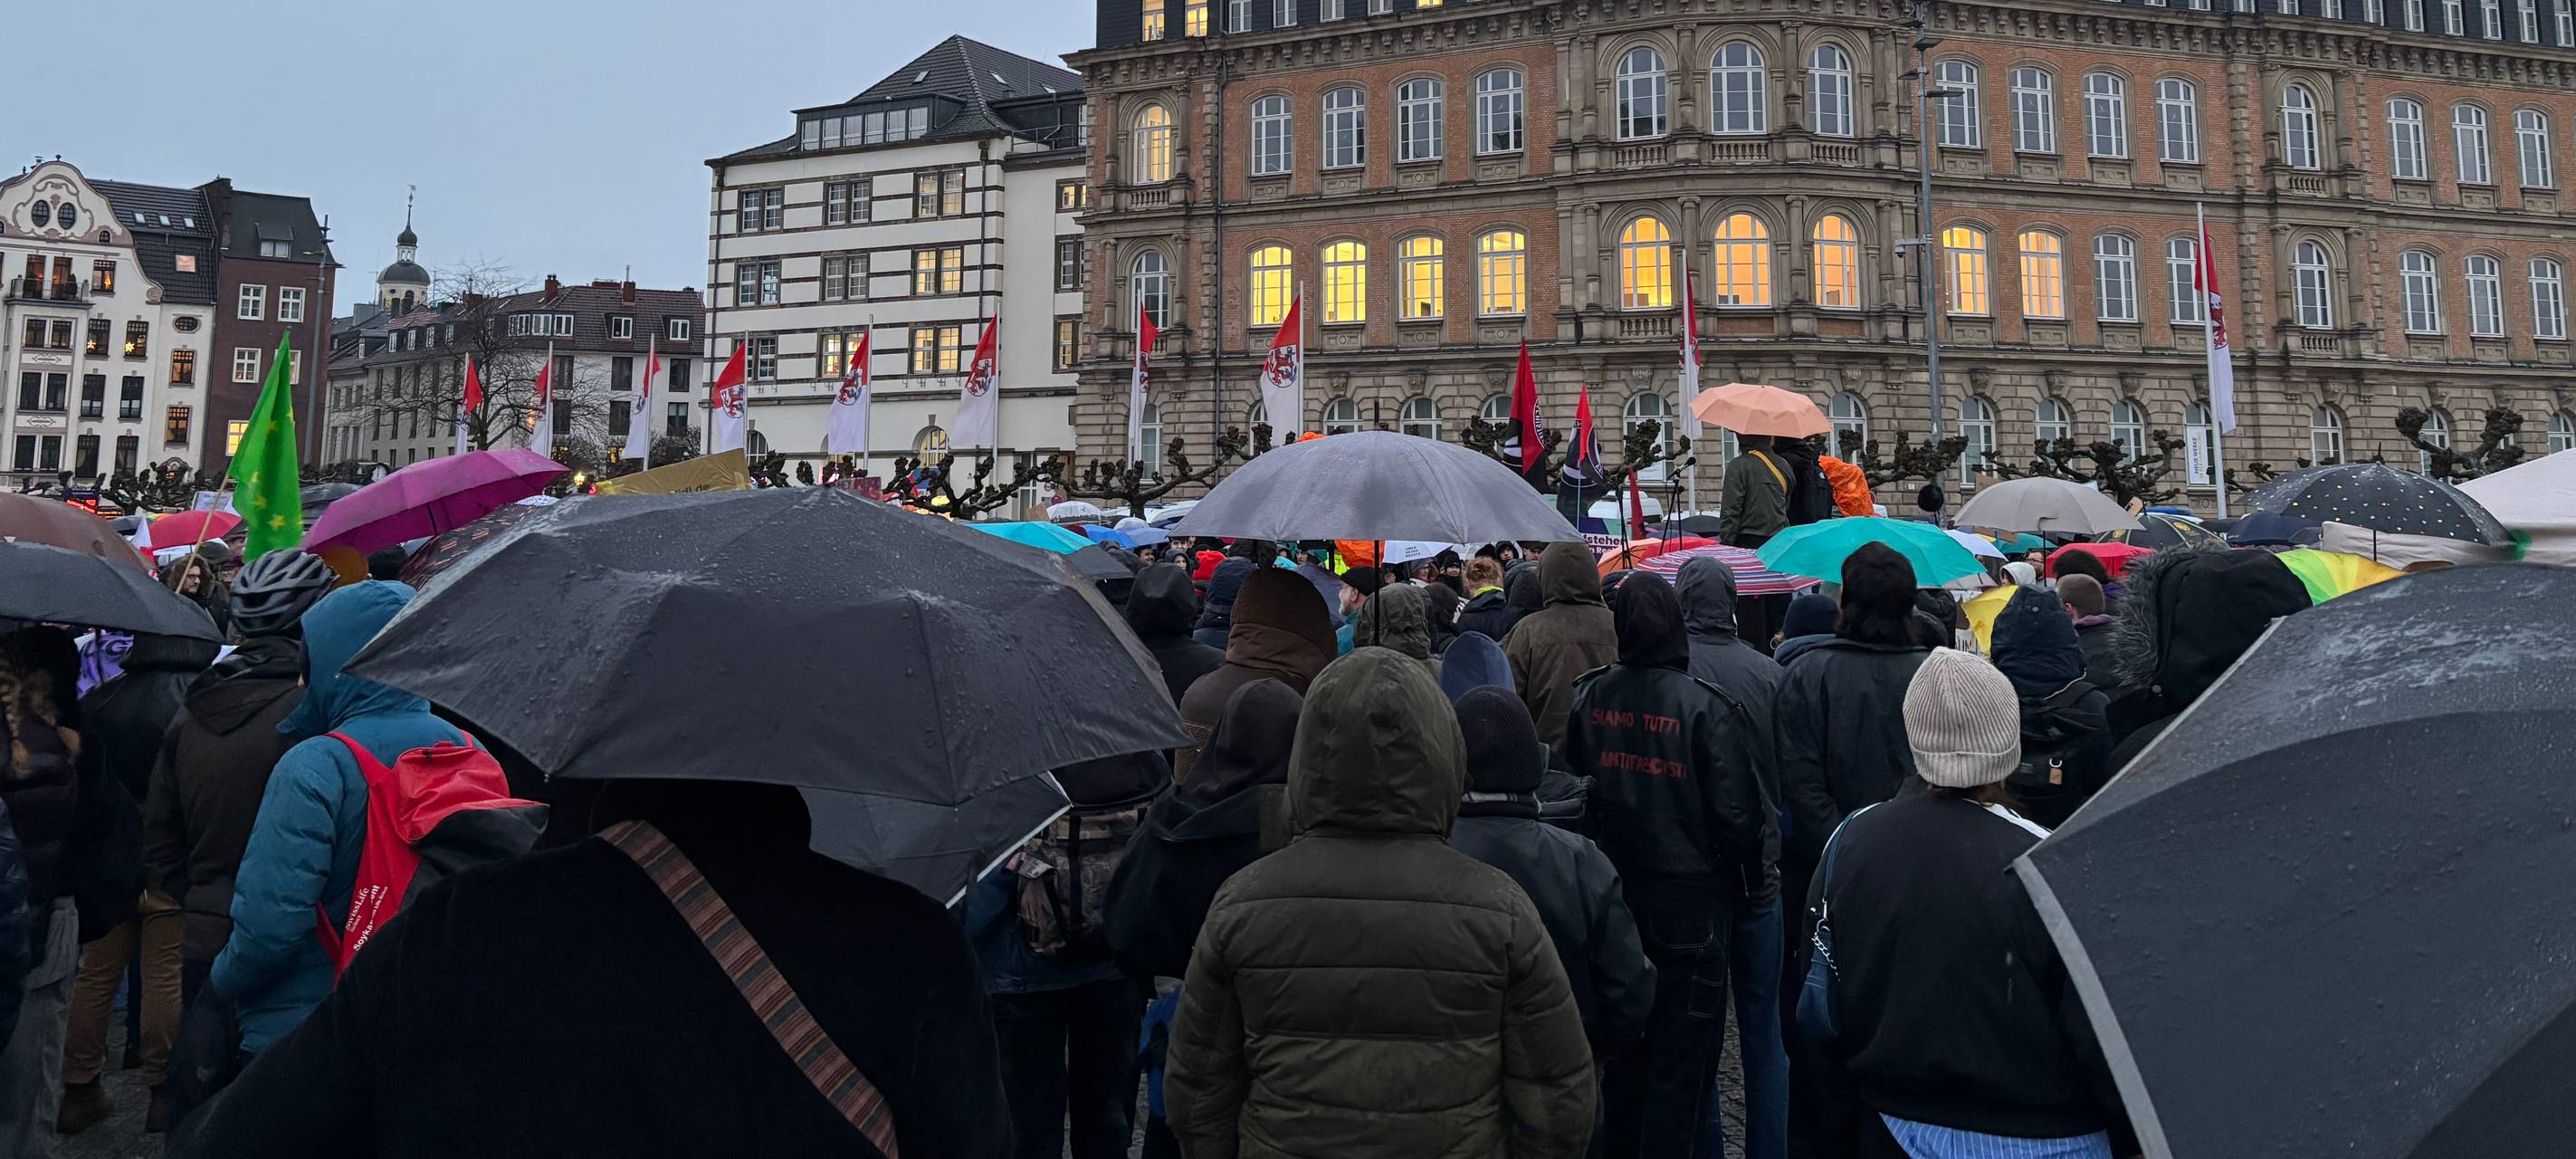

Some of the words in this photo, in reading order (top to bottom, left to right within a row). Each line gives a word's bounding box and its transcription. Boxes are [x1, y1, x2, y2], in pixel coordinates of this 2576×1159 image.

[1591, 709, 1635, 728] SIAMO
[1642, 713, 1681, 738] TUTTI
[1599, 751, 1688, 778] ANTIFASCISTI
